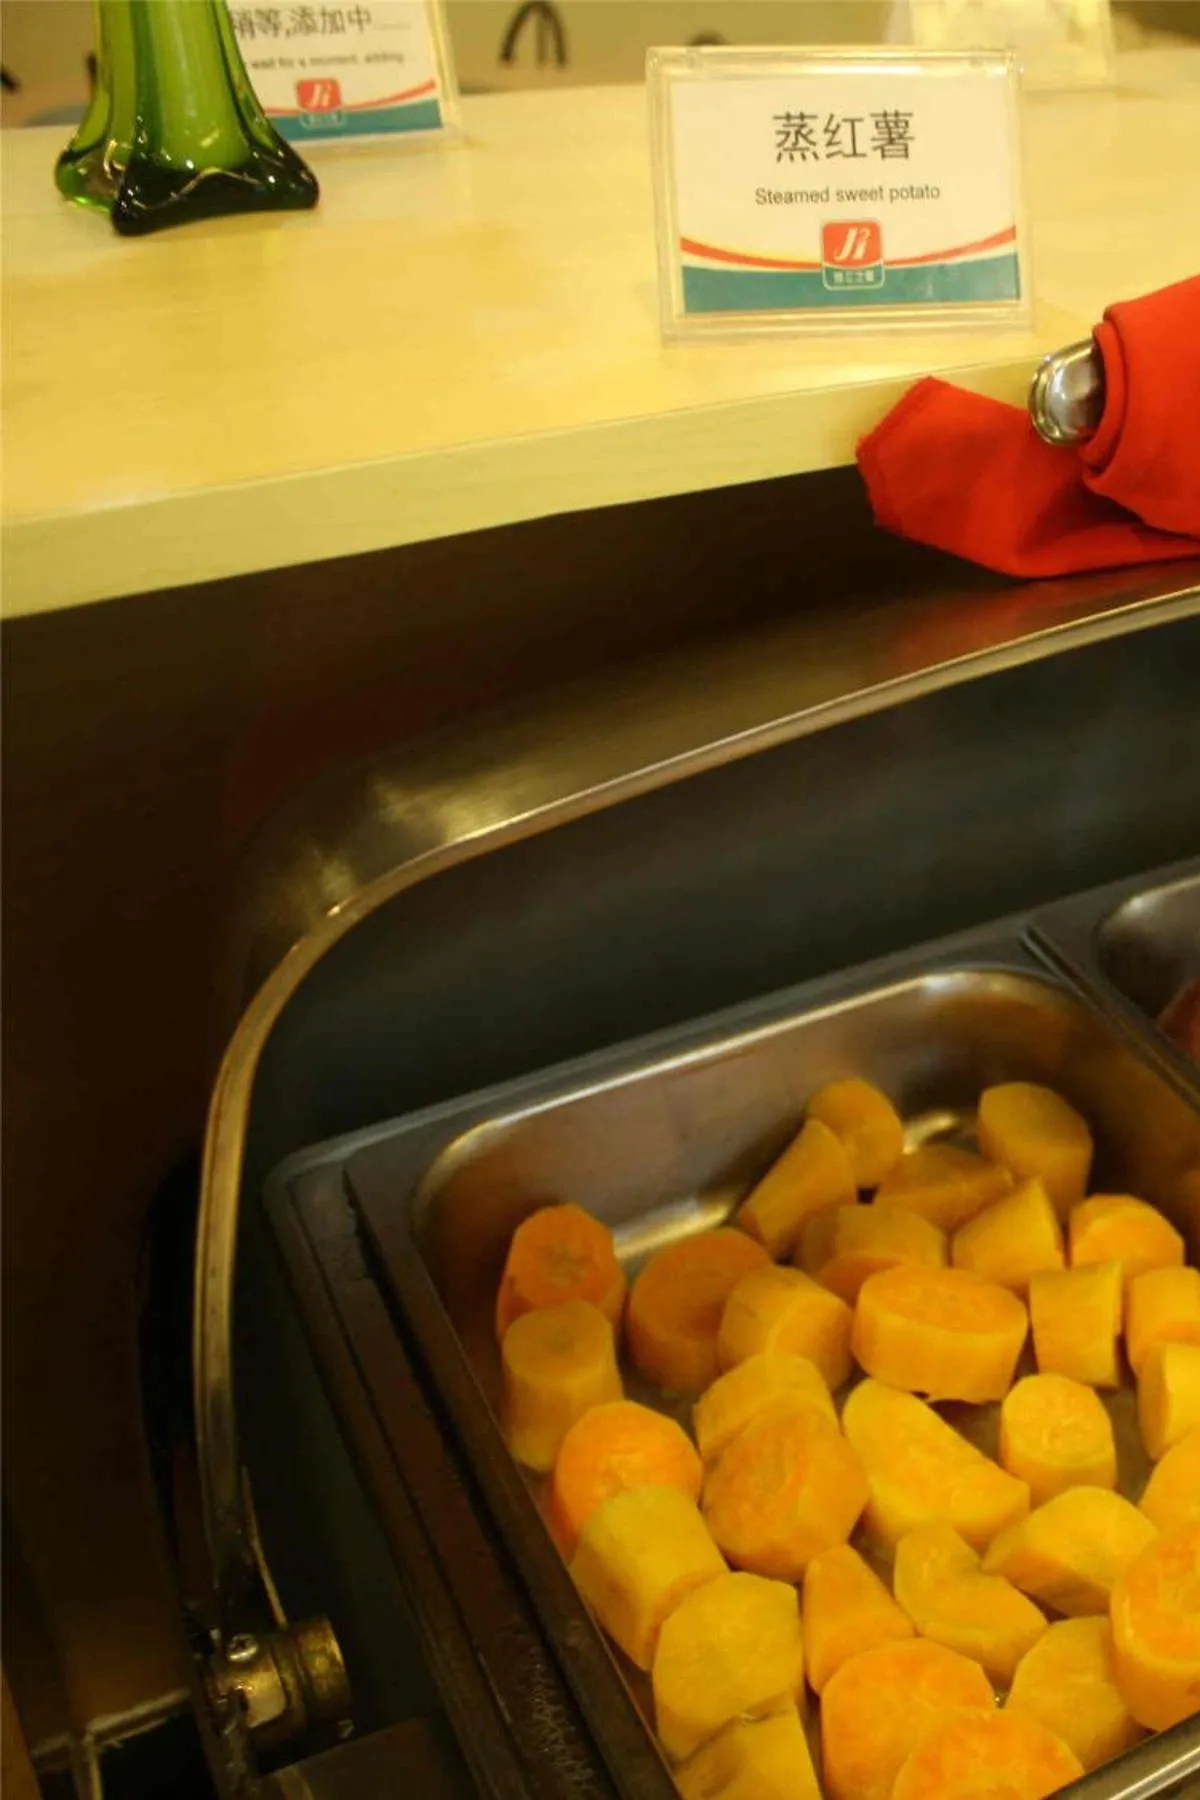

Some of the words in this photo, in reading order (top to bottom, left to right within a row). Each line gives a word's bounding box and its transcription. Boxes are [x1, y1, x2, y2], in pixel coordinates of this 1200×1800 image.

[773, 109, 915, 162] 蒸红薯
[755, 187, 830, 206] Steamed
[835, 186, 884, 202] sweet
[889, 184, 941, 204] potato
